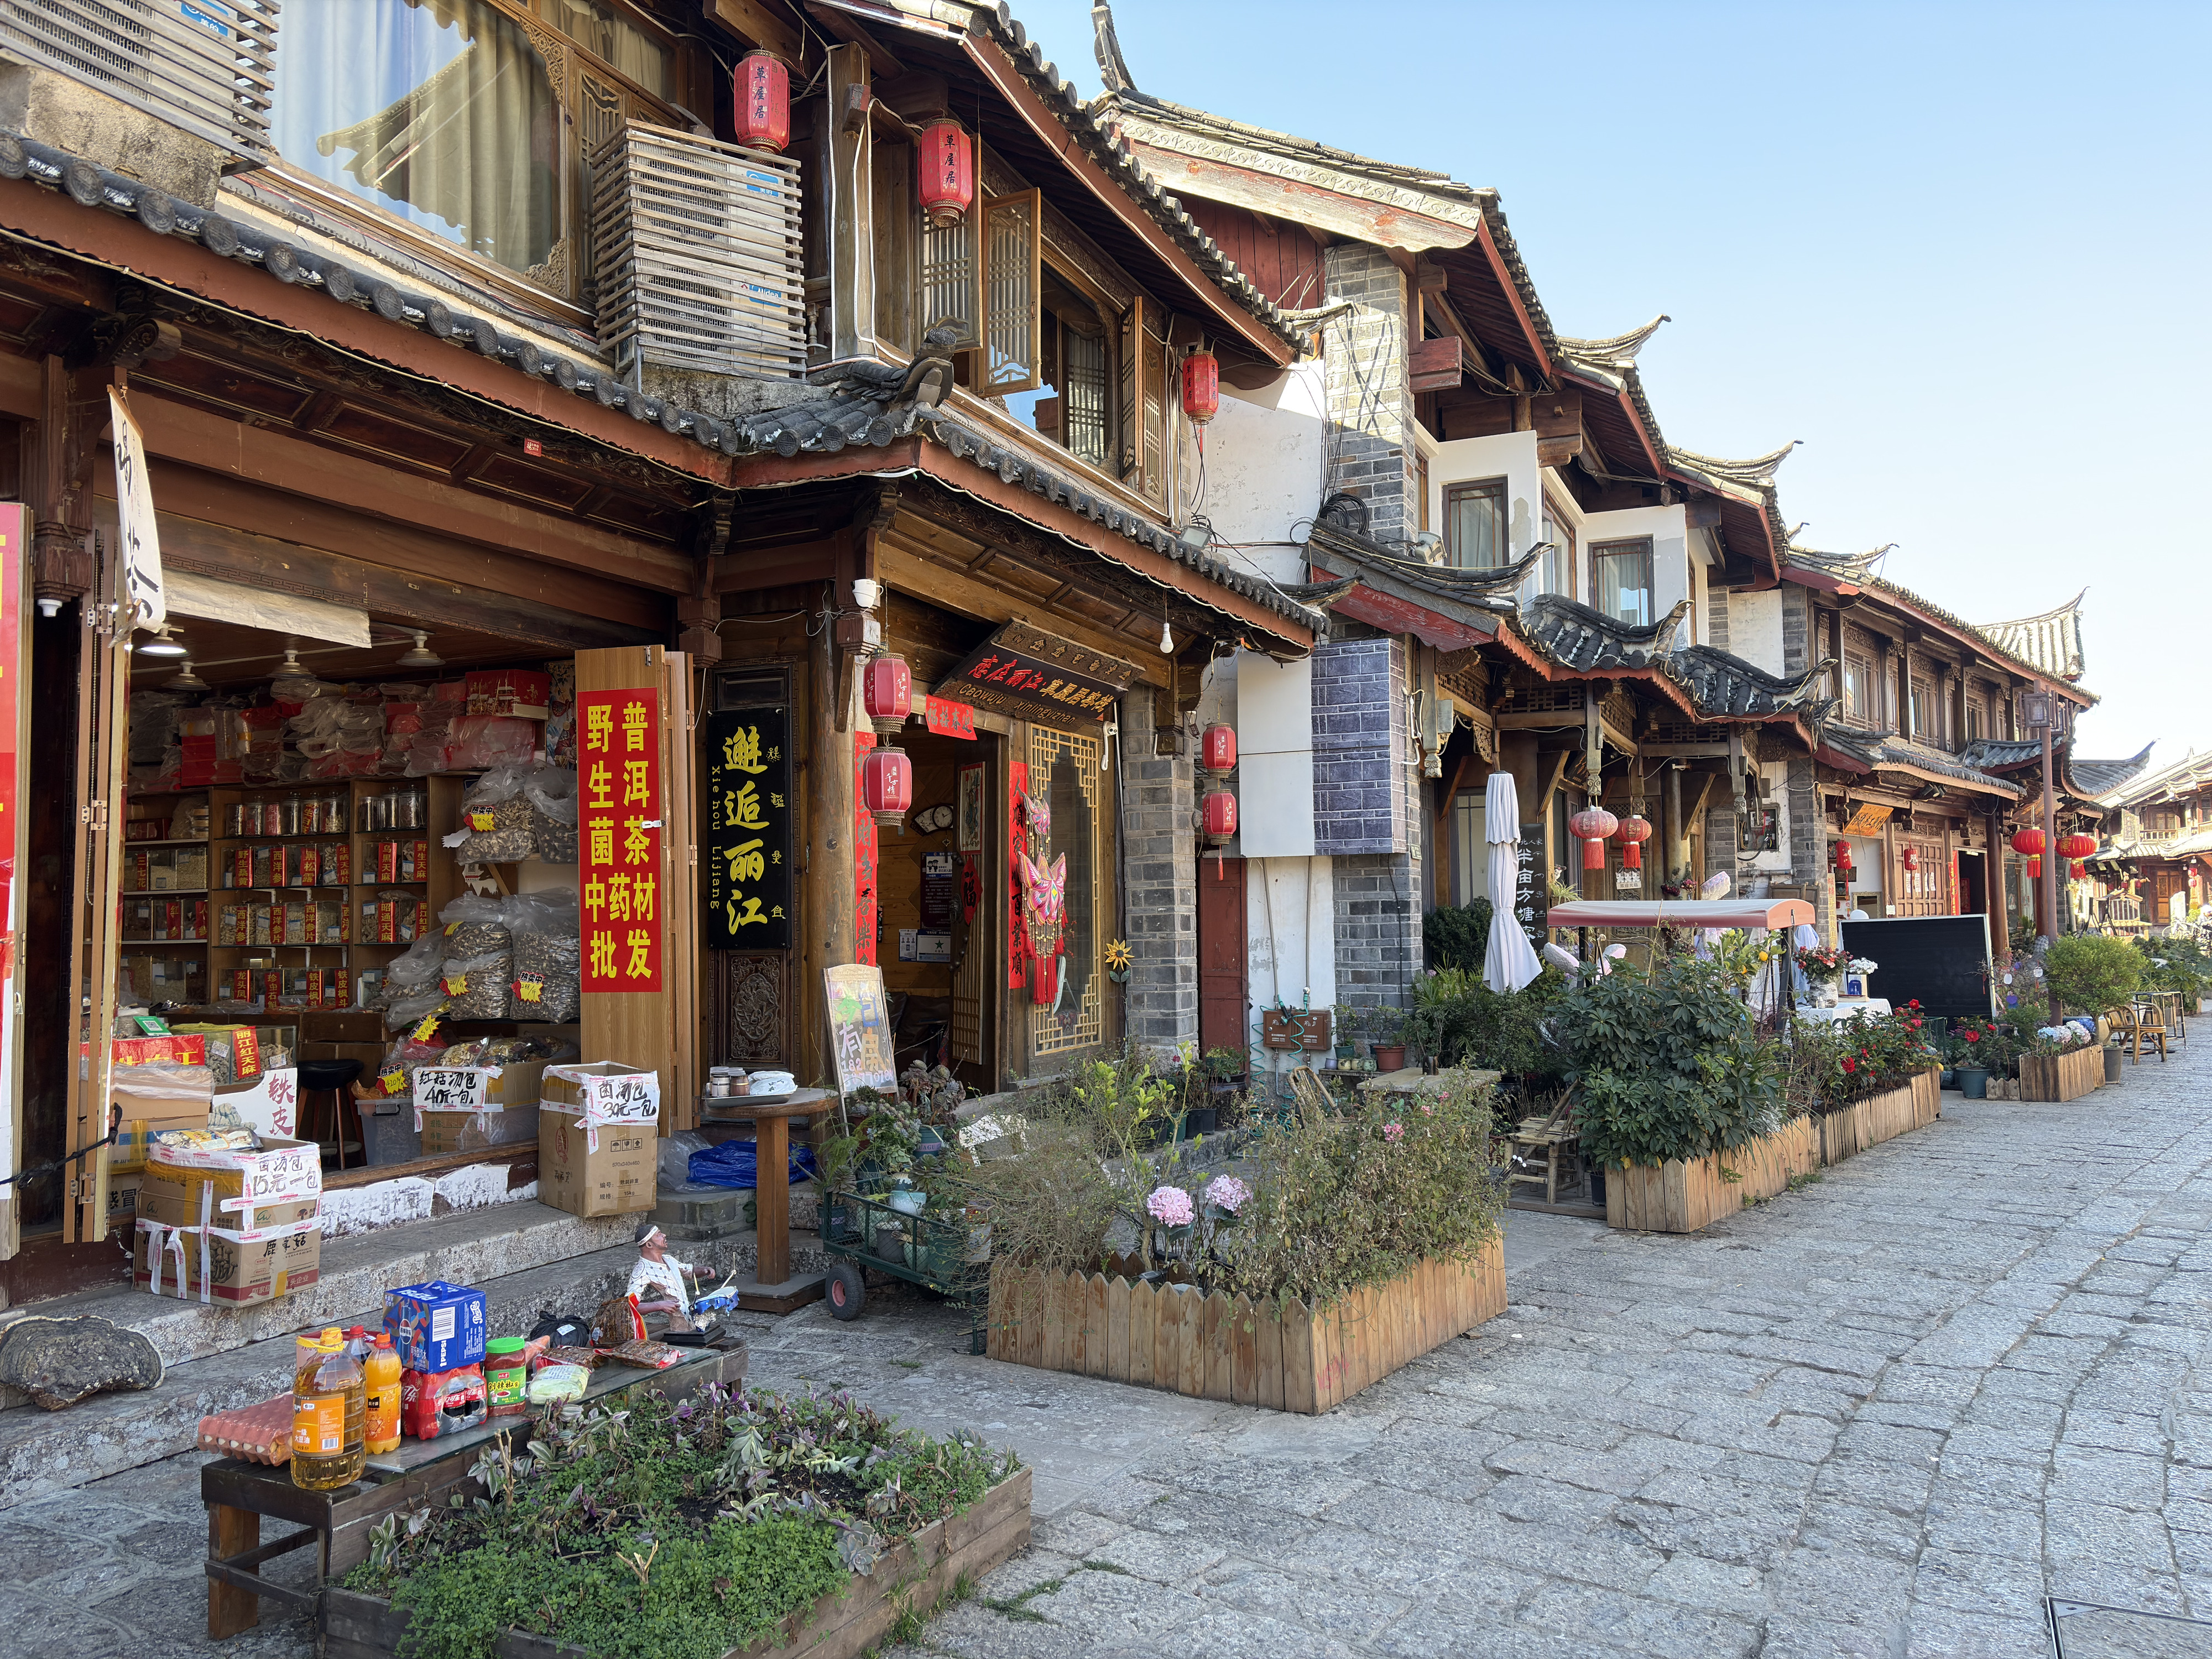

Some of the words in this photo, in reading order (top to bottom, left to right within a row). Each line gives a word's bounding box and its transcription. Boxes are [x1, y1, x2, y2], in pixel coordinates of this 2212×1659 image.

[753, 66, 766, 119] 草屋居
[945, 134, 956, 184] 草屋居
[757, 287, 779, 299] Midea
[865, 679, 874, 701] 千古情
[896, 679, 907, 701] 千古情
[959, 684, 1009, 705] Caowuju
[1014, 701, 1076, 724] xinlingyizhan
[1217, 740, 1226, 756] 千古情
[587, 705, 613, 866] 野生菌
[622, 701, 650, 865] 普洱茶
[712, 766, 720, 792] Xie
[885, 773, 898, 795] 千古情
[471, 806, 493, 815] 热卖中
[1224, 807, 1233, 822] 千古情
[723, 726, 770, 935] 邂逅丽江
[137, 857, 146, 888] 三七花
[238, 851, 248, 886] 野生桑黄
[273, 851, 283, 883] 西洋参
[303, 850, 315, 883] 黑松露
[382, 844, 392, 881] 乌黑天麻
[416, 843, 426, 878] 野生天麻
[710, 846, 721, 910] Lijiang
[963, 871, 977, 908] 福
[585, 873, 655, 922] 中药材
[1517, 848, 1536, 941] 半亩方塘客
[236, 910, 247, 942] 西洋参
[272, 907, 283, 943] 西洋参片
[305, 905, 315, 941] 西洋参片
[381, 903, 392, 942] 昭通天麻
[419, 902, 427, 939] 丽江红天
[589, 929, 653, 979] 批发
[237, 971, 247, 999] 龙头凤
[337, 970, 348, 1008] 铁皮枫斗
[520, 972, 543, 984] 热卖中
[837, 990, 880, 1027] 今日
[235, 1029, 257, 1076] 丽江红天麻
[841, 1057, 863, 1072] 182
[380, 1063, 401, 1077] 热卖中
[598, 1079, 648, 1103] 菌汤包
[603, 1099, 657, 1118] 30元一包
[258, 1155, 303, 1172] 菌汤包
[253, 1167, 318, 1196] 15元一包
[397, 1289, 438, 1301] PEPSI
[400, 1327, 411, 1335] 百事可乐
[295, 1435, 310, 1444] 大豆油
